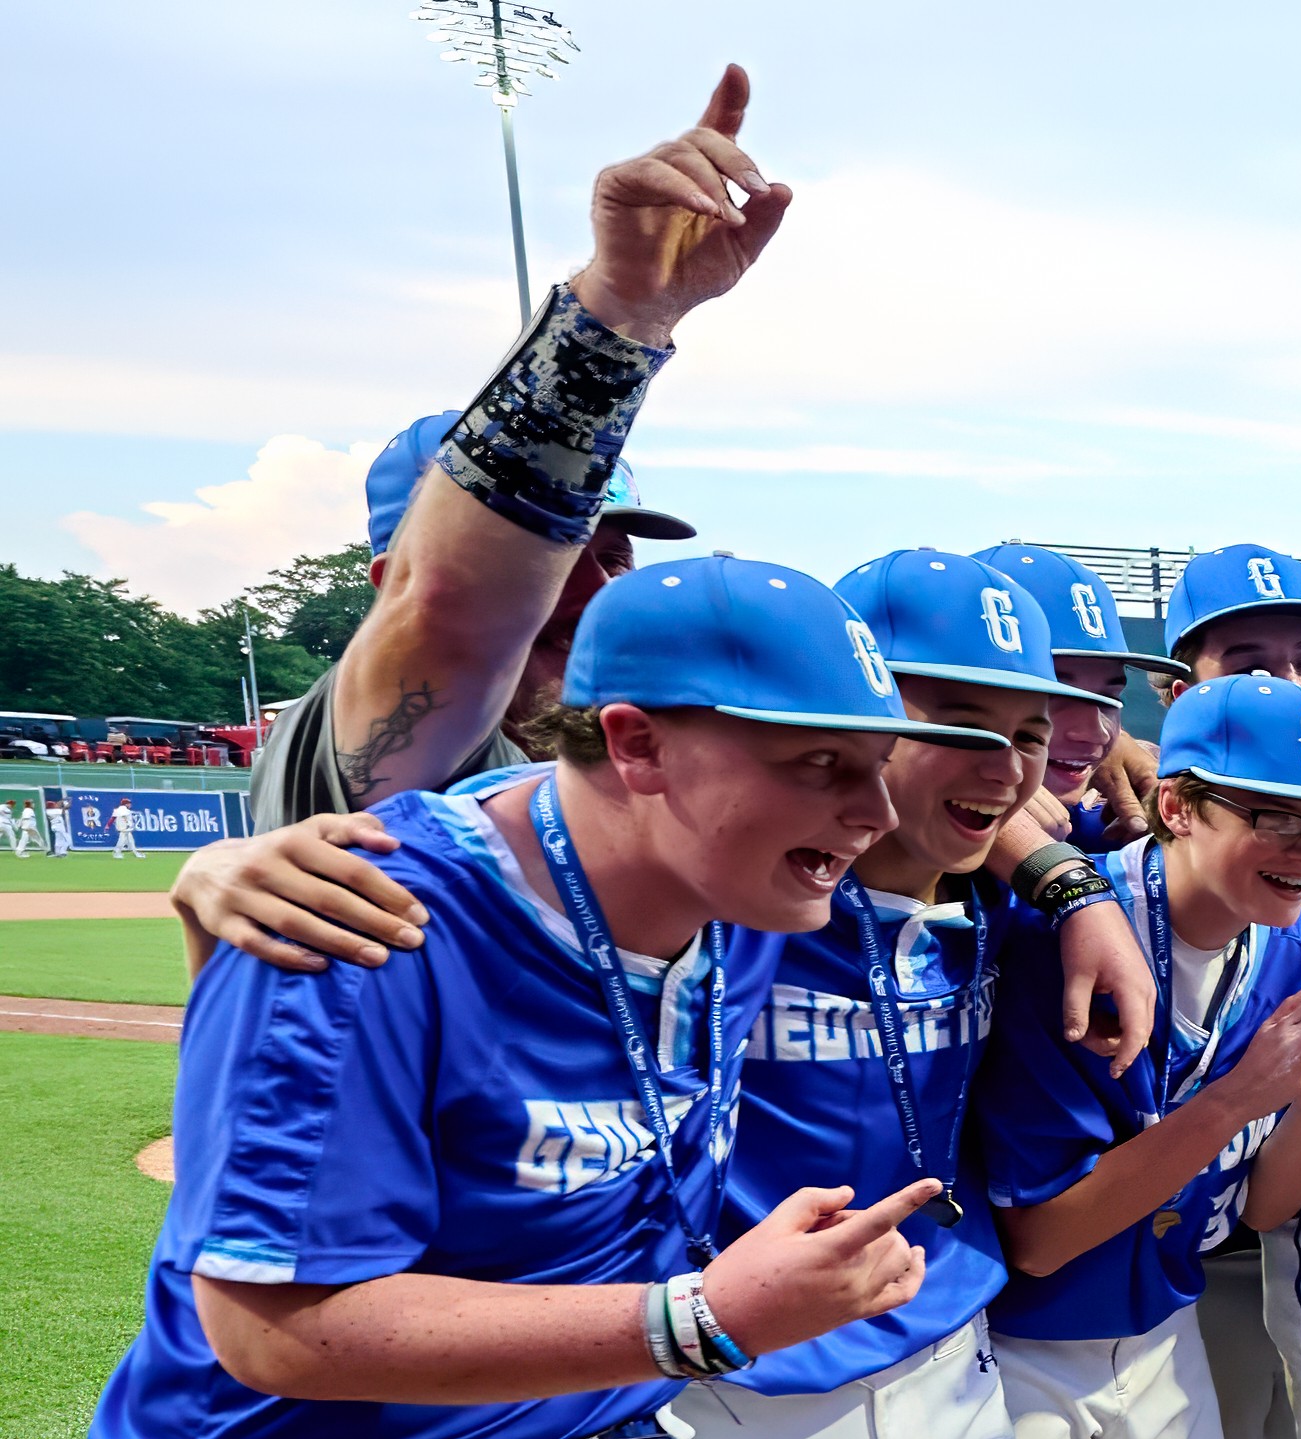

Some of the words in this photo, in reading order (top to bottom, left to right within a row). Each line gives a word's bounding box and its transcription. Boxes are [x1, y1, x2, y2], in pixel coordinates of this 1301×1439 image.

[1247, 557, 1286, 599] G
[980, 585, 1023, 655] G
[1070, 582, 1108, 639] G
[845, 618, 895, 699] G
[131, 808, 178, 833] able
